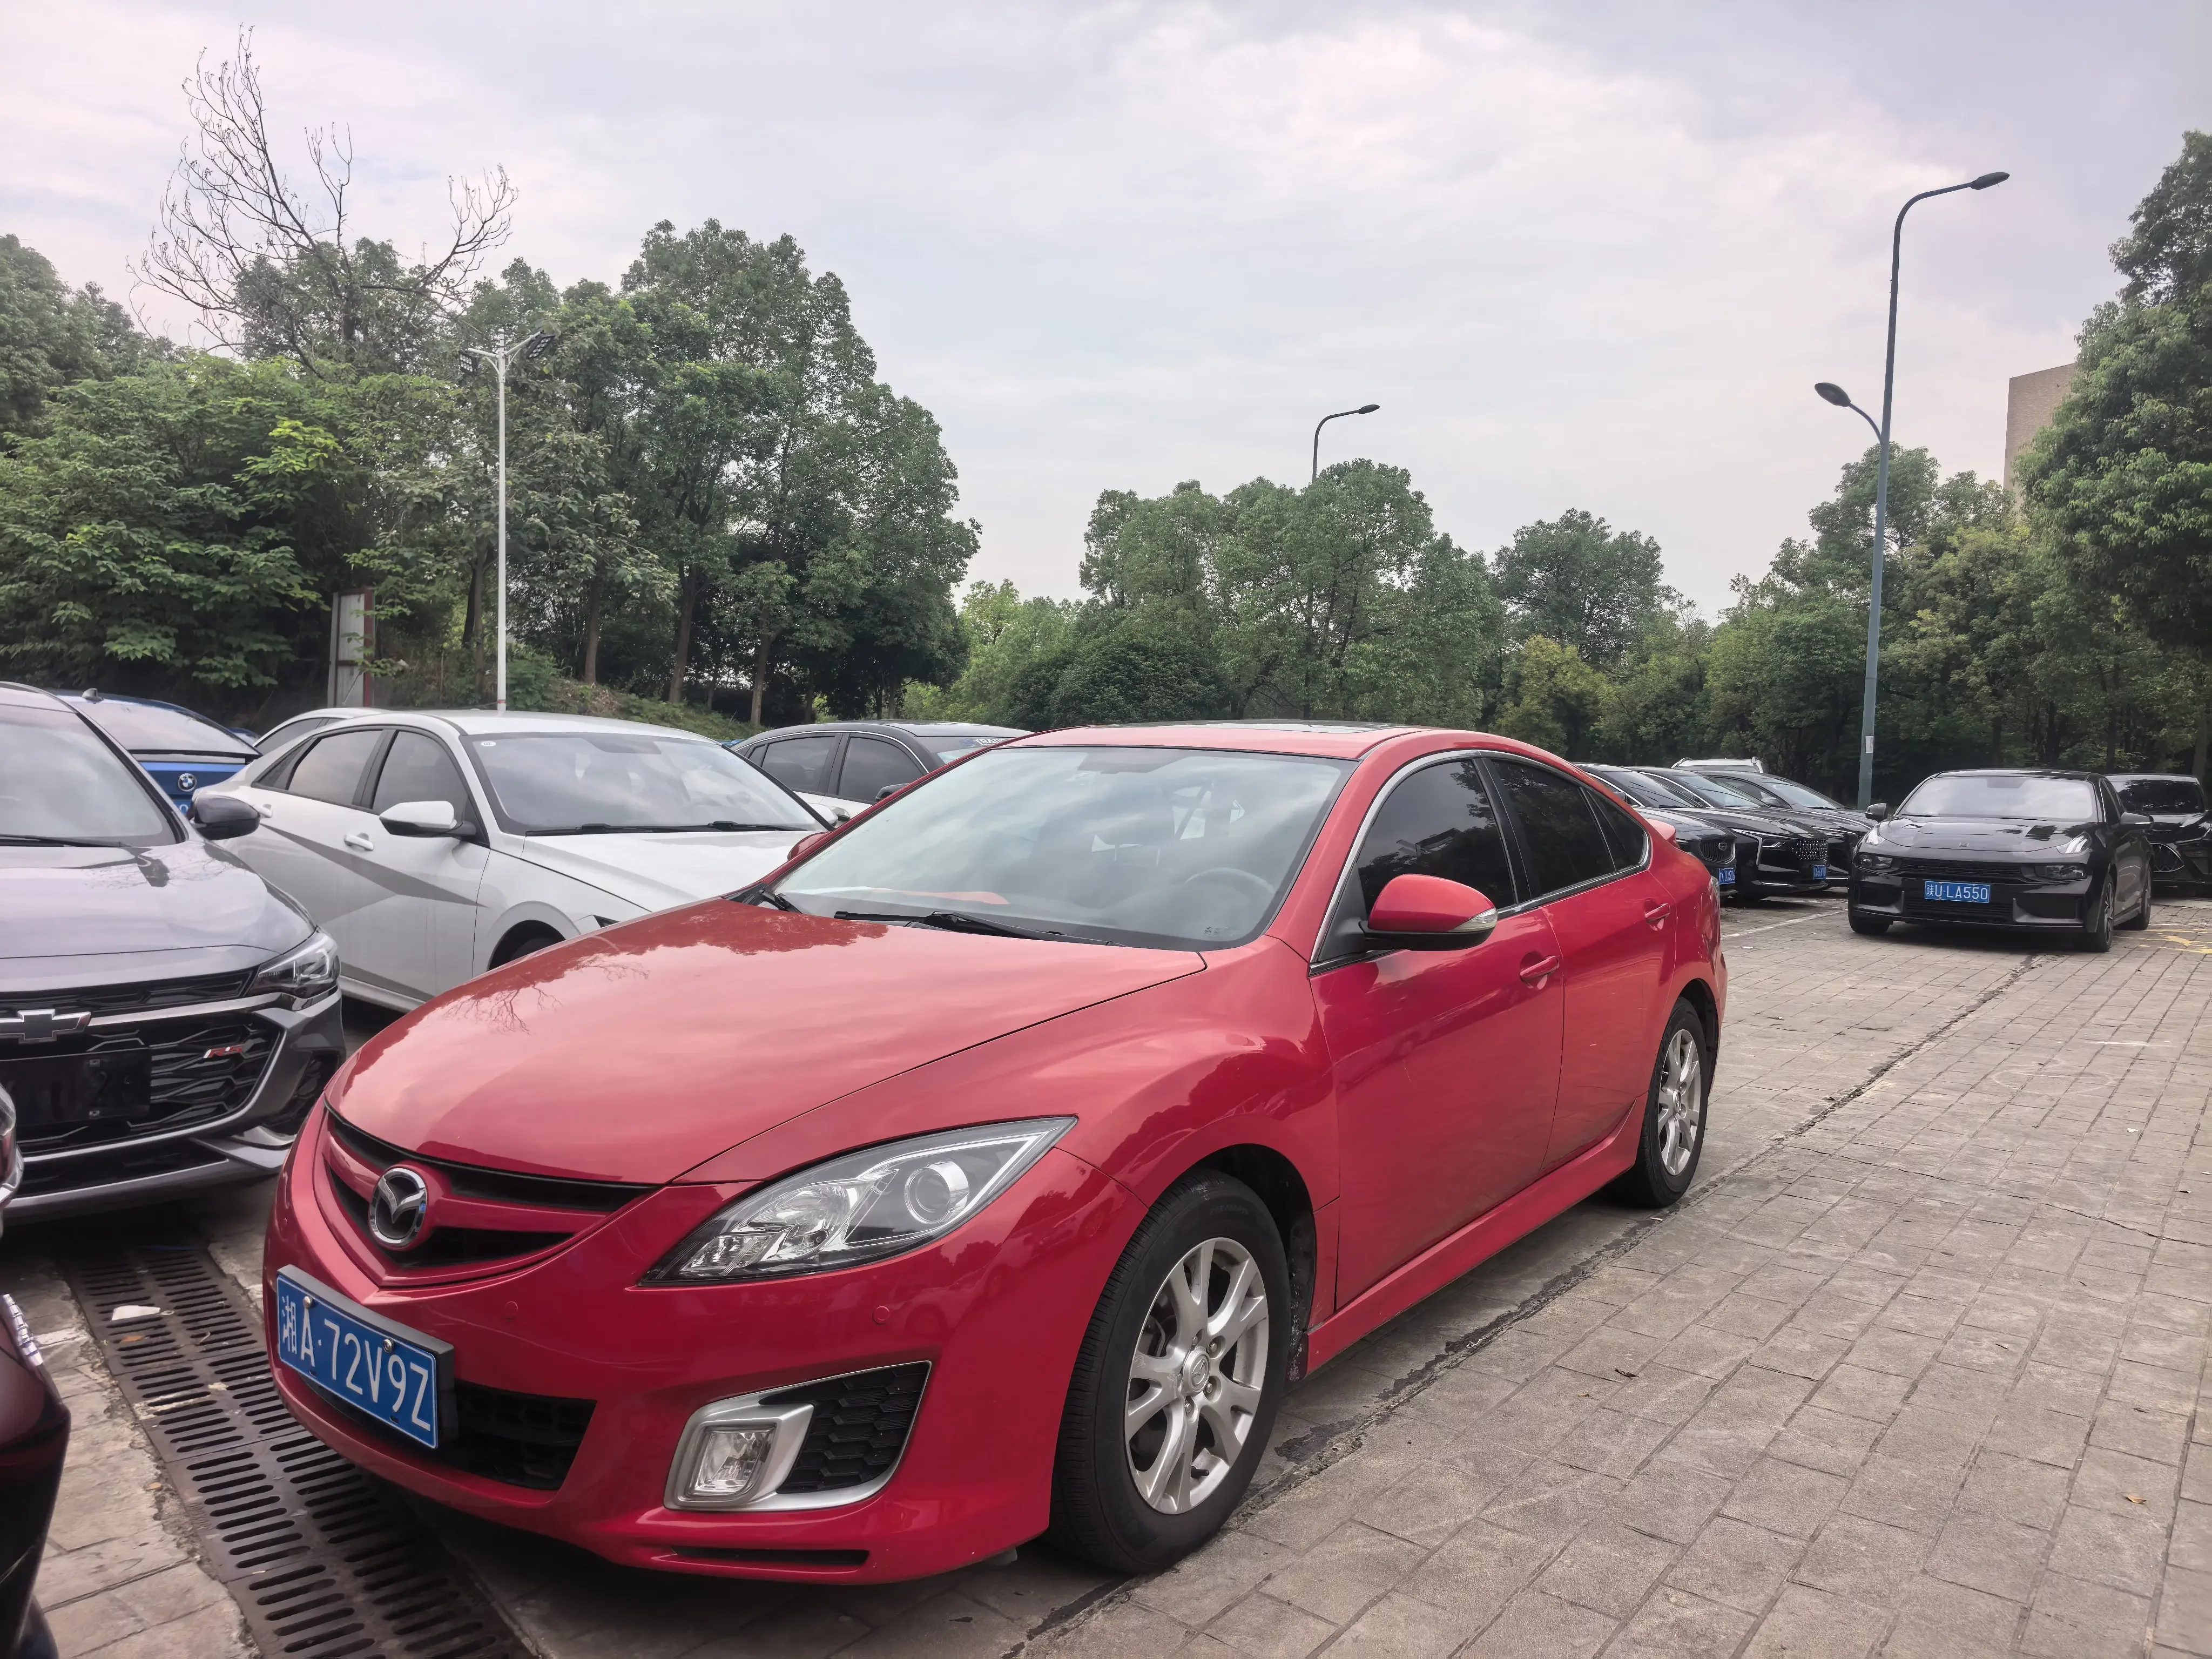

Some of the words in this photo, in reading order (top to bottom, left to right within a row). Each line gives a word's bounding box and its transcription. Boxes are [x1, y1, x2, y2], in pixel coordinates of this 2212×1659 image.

[1926, 884, 1988, 900] 陕U·LA550
[203, 1045, 243, 1058] RS
[281, 1294, 431, 1432] 湘A·72V9Z
